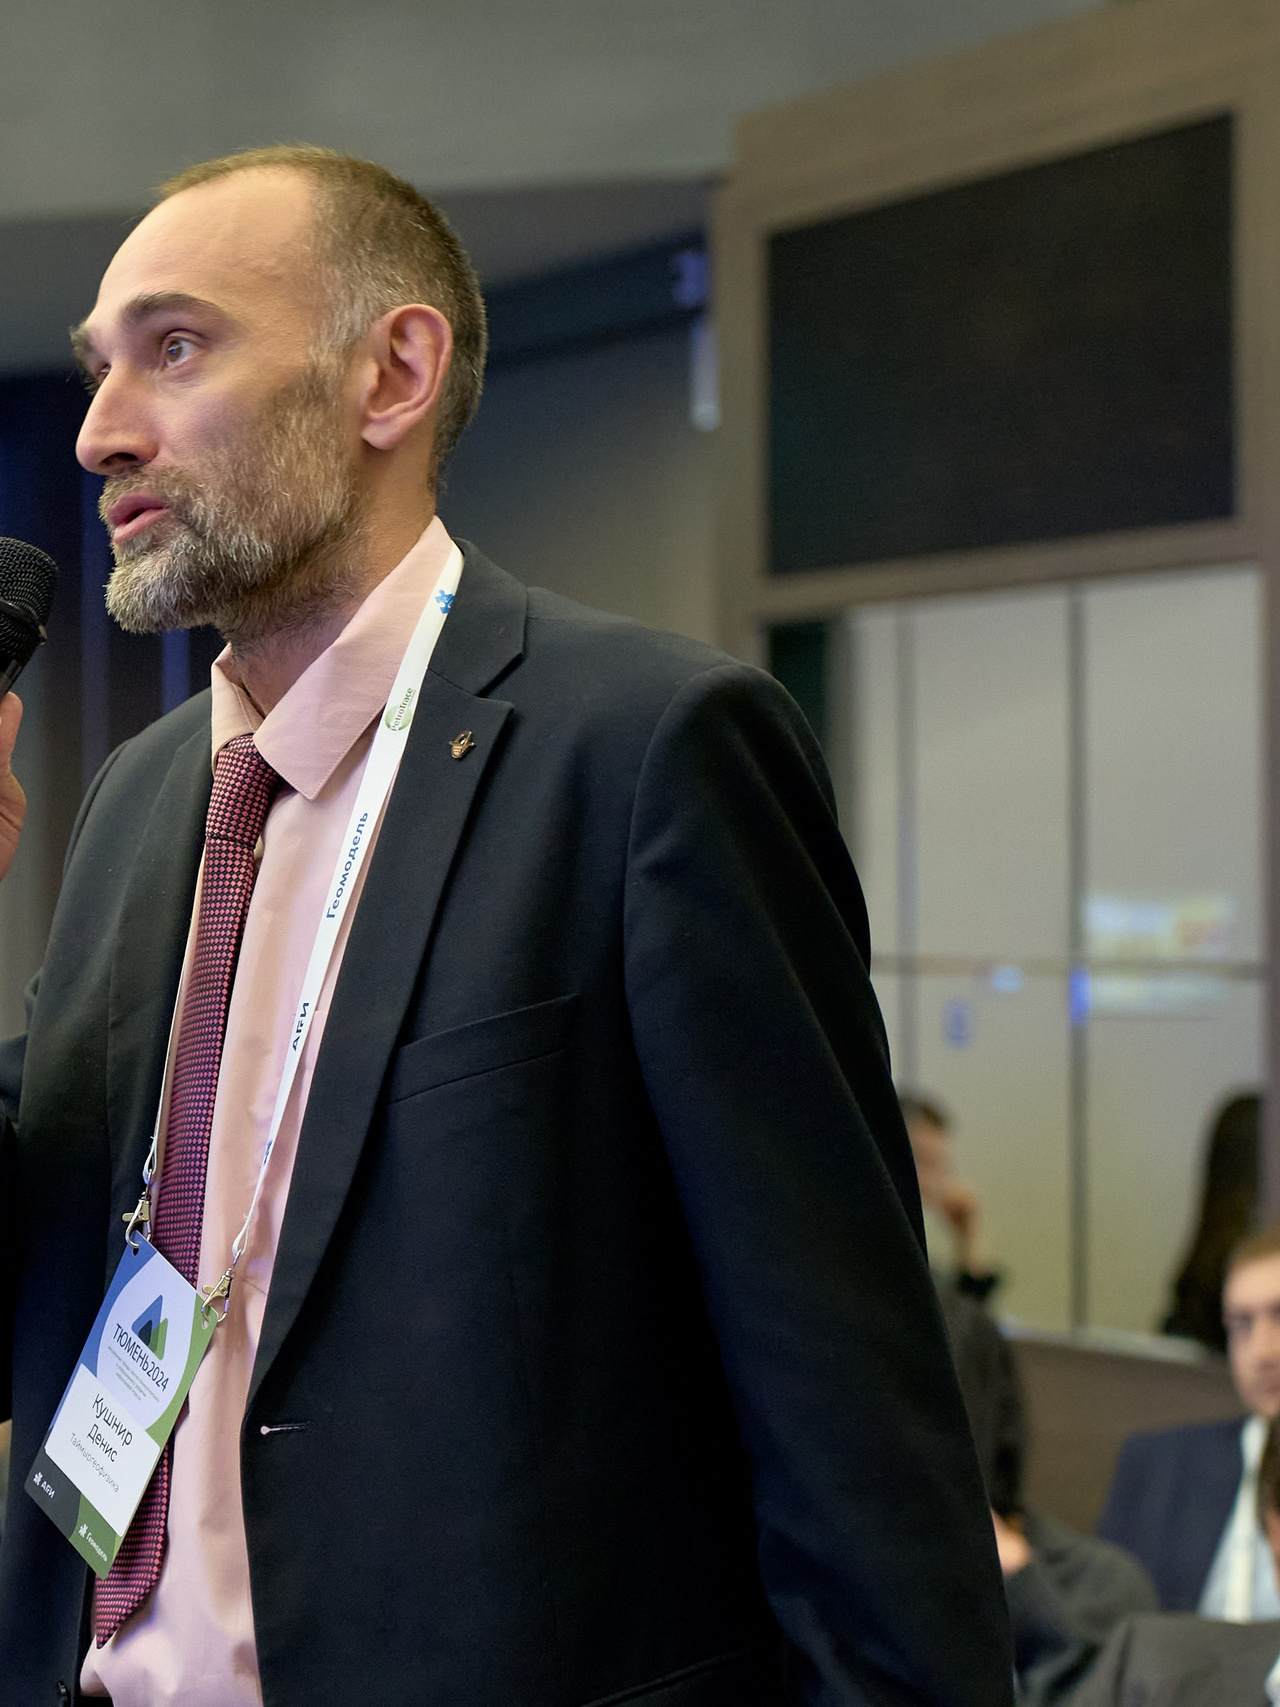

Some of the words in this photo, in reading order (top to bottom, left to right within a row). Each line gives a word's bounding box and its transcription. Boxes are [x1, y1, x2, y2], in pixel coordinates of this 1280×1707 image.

[391, 686, 413, 731] PetroTrace
[326, 812, 368, 918] Геомодель
[113, 1323, 169, 1392] ТЮМЕНЬ2024
[87, 1423, 118, 1463] Денис
[92, 1393, 133, 1447] Кушнир
[70, 1432, 119, 1493] Таймыргеофизика
